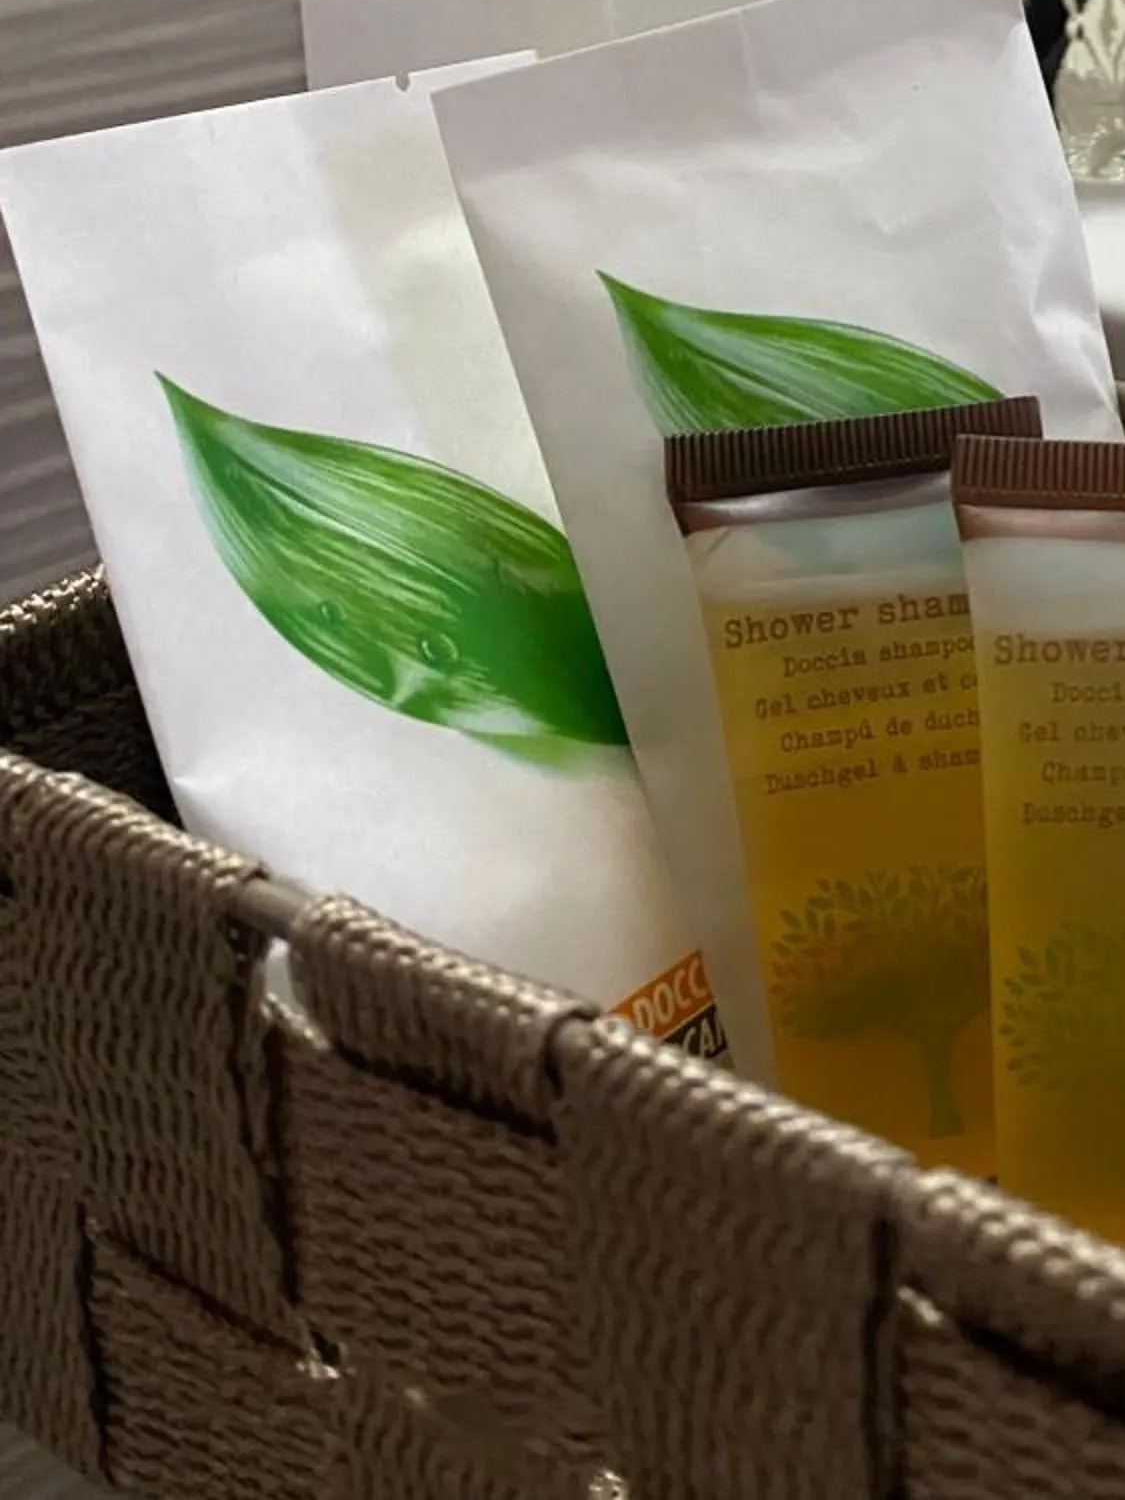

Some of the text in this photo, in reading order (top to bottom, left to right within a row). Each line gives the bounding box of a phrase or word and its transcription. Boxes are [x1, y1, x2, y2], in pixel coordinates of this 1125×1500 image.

[724, 606, 860, 649] Shower
[782, 646, 868, 678] Doccia
[755, 693, 798, 720] Gel
[806, 680, 911, 711] cheveux
[922, 673, 949, 695] et
[886, 715, 913, 737] de
[1018, 721, 1060, 743] Gel
[765, 758, 880, 795] Duschgel
